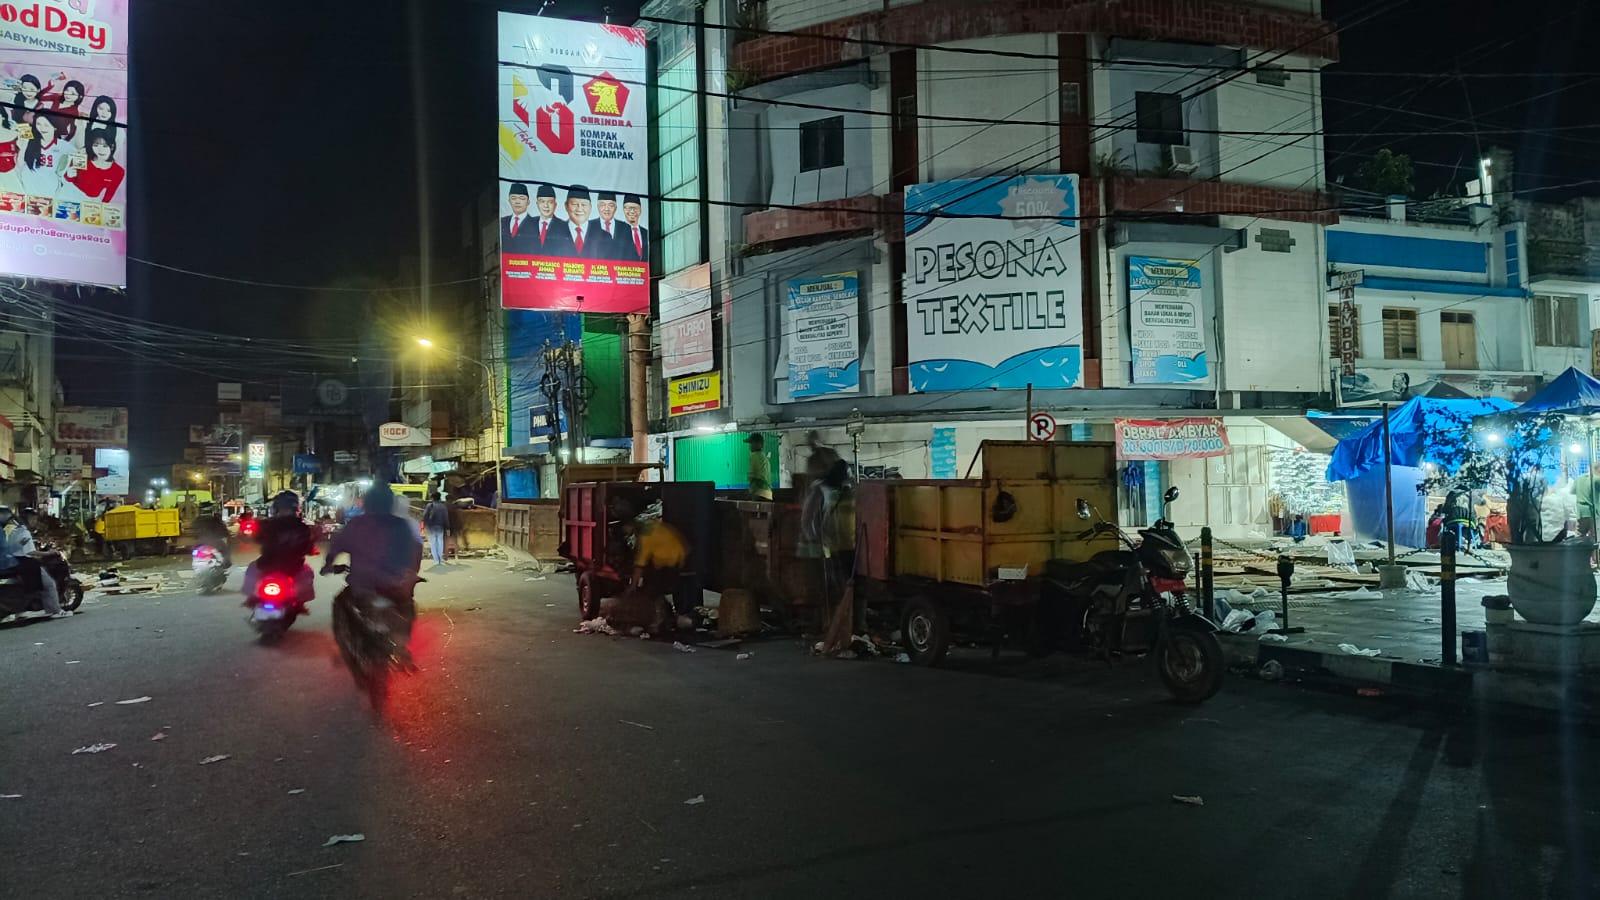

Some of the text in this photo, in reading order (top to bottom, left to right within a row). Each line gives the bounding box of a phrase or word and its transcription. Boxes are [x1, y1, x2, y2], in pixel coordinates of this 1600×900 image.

[45, 6, 106, 50] Day
[581, 116, 633, 128] GERINDRA
[580, 129, 617, 140] KOMPAK
[580, 139, 624, 150] BERGERAK
[580, 148, 634, 160] BERDAMPAK
[914, 236, 1067, 284] PESONA
[917, 290, 1065, 335] TEXTILE
[1341, 287, 1354, 376] TAMBORA
[678, 378, 709, 394] SHIMIZU
[1123, 424, 1219, 440] OBRAL AMBYAR
[1185, 438, 1226, 453] 70.000
